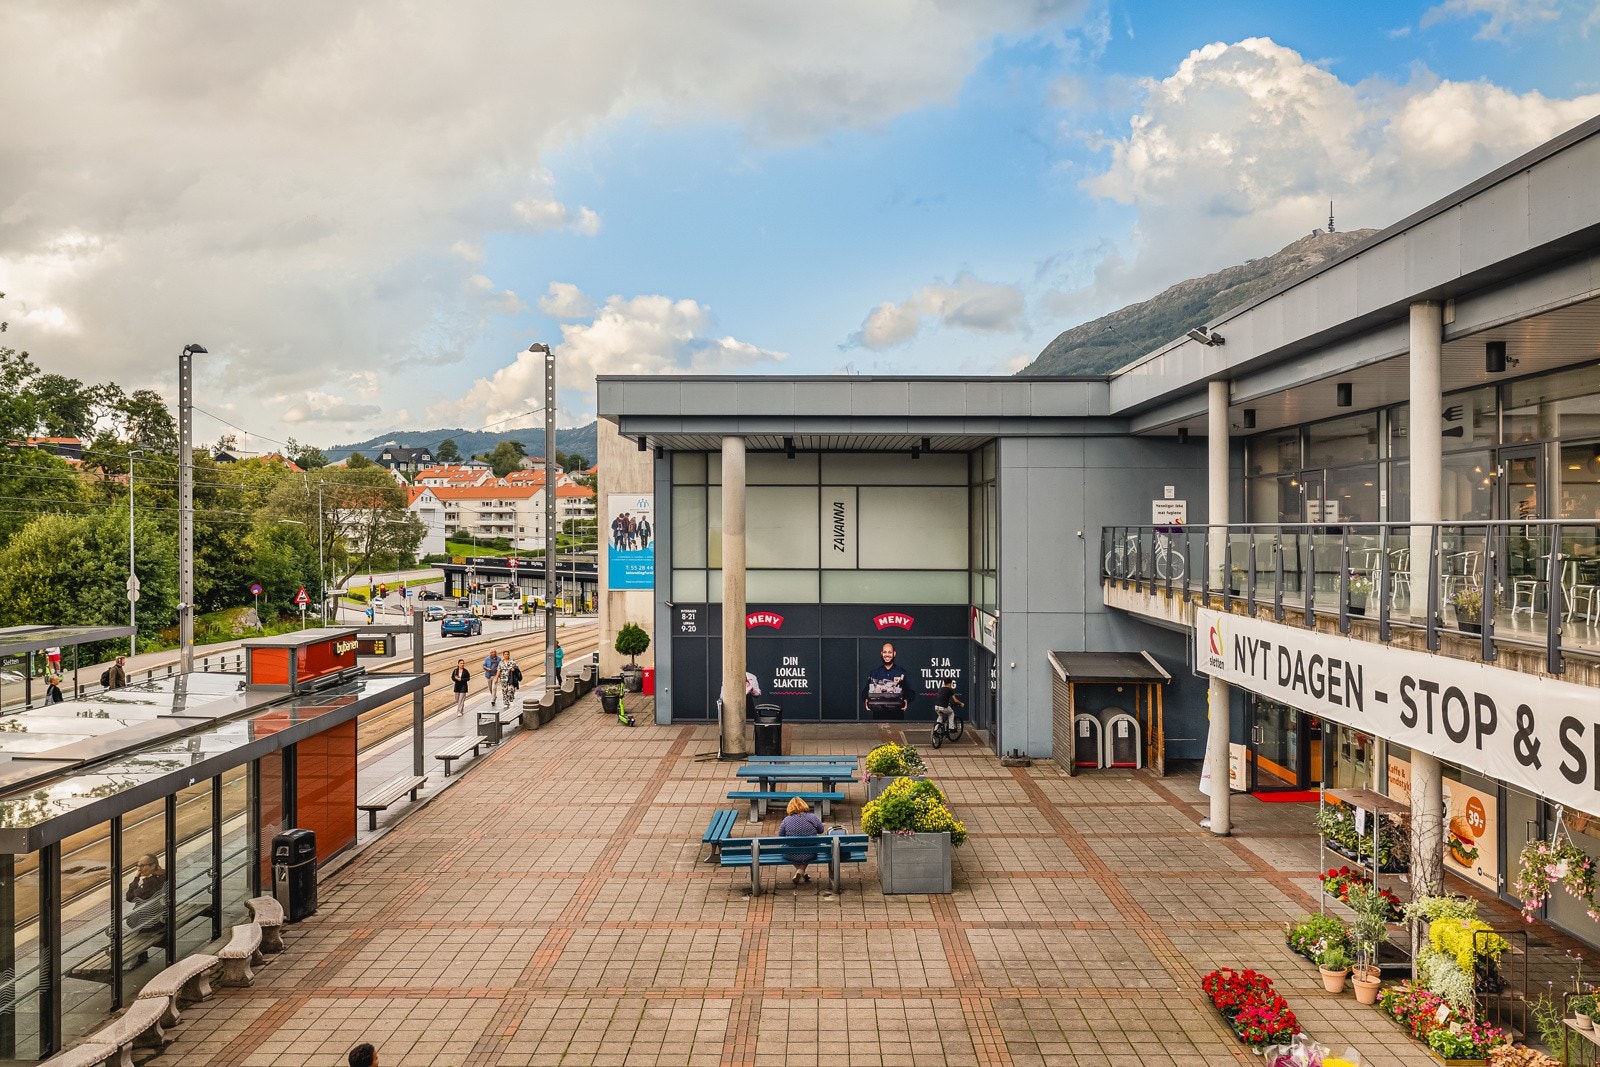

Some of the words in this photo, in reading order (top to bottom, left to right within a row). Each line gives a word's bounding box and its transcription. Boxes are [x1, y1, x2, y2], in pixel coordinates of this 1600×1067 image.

[833, 501, 845, 553] ZAVANNA
[748, 615, 780, 625] MENY
[878, 615, 910, 626] MENY
[336, 640, 359, 656] bybanen
[2, 658, 20, 667] Sletten
[783, 656, 798, 666] DIN
[931, 657, 939, 667] SI
[940, 657, 951, 667] JA
[1209, 656, 1225, 671] sletten
[775, 667, 806, 677] LOKALE
[920, 668, 933, 678] TIL
[935, 668, 961, 678] STORT
[773, 678, 808, 688] SLAKTER
[1234, 633, 1271, 681] NYT
[1278, 645, 1363, 712] DAGEN
[1399, 675, 1498, 751] STOP
[1513, 703, 1542, 770] &
